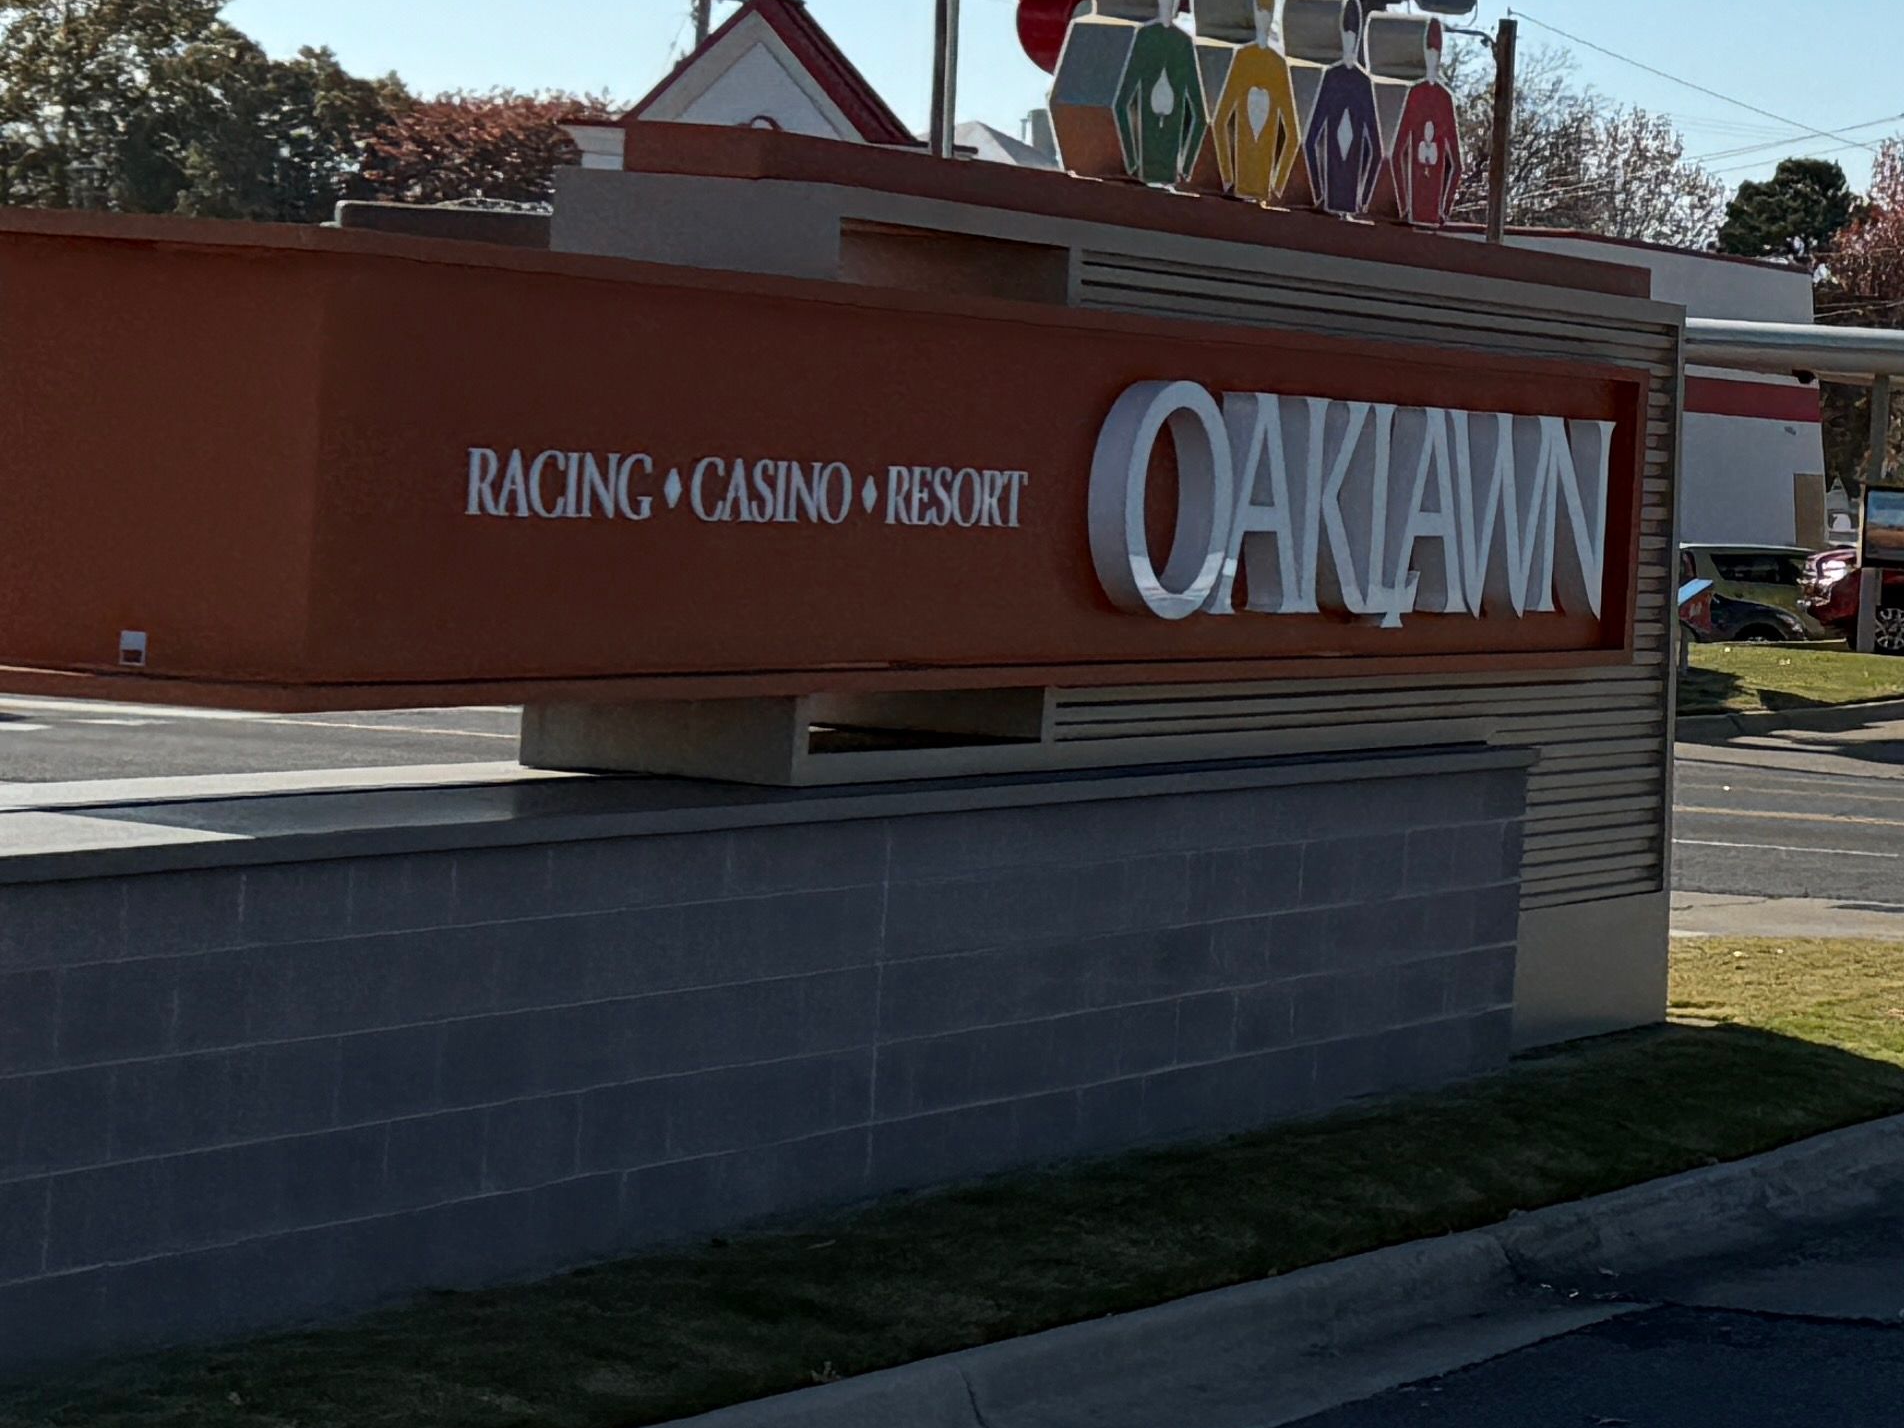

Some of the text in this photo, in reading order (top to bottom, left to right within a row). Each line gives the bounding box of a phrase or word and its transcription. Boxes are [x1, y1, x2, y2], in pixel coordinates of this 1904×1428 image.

[465, 447, 1028, 528] RACING CASINO RESORT
[1088, 380, 1616, 628] OAKLAWN
